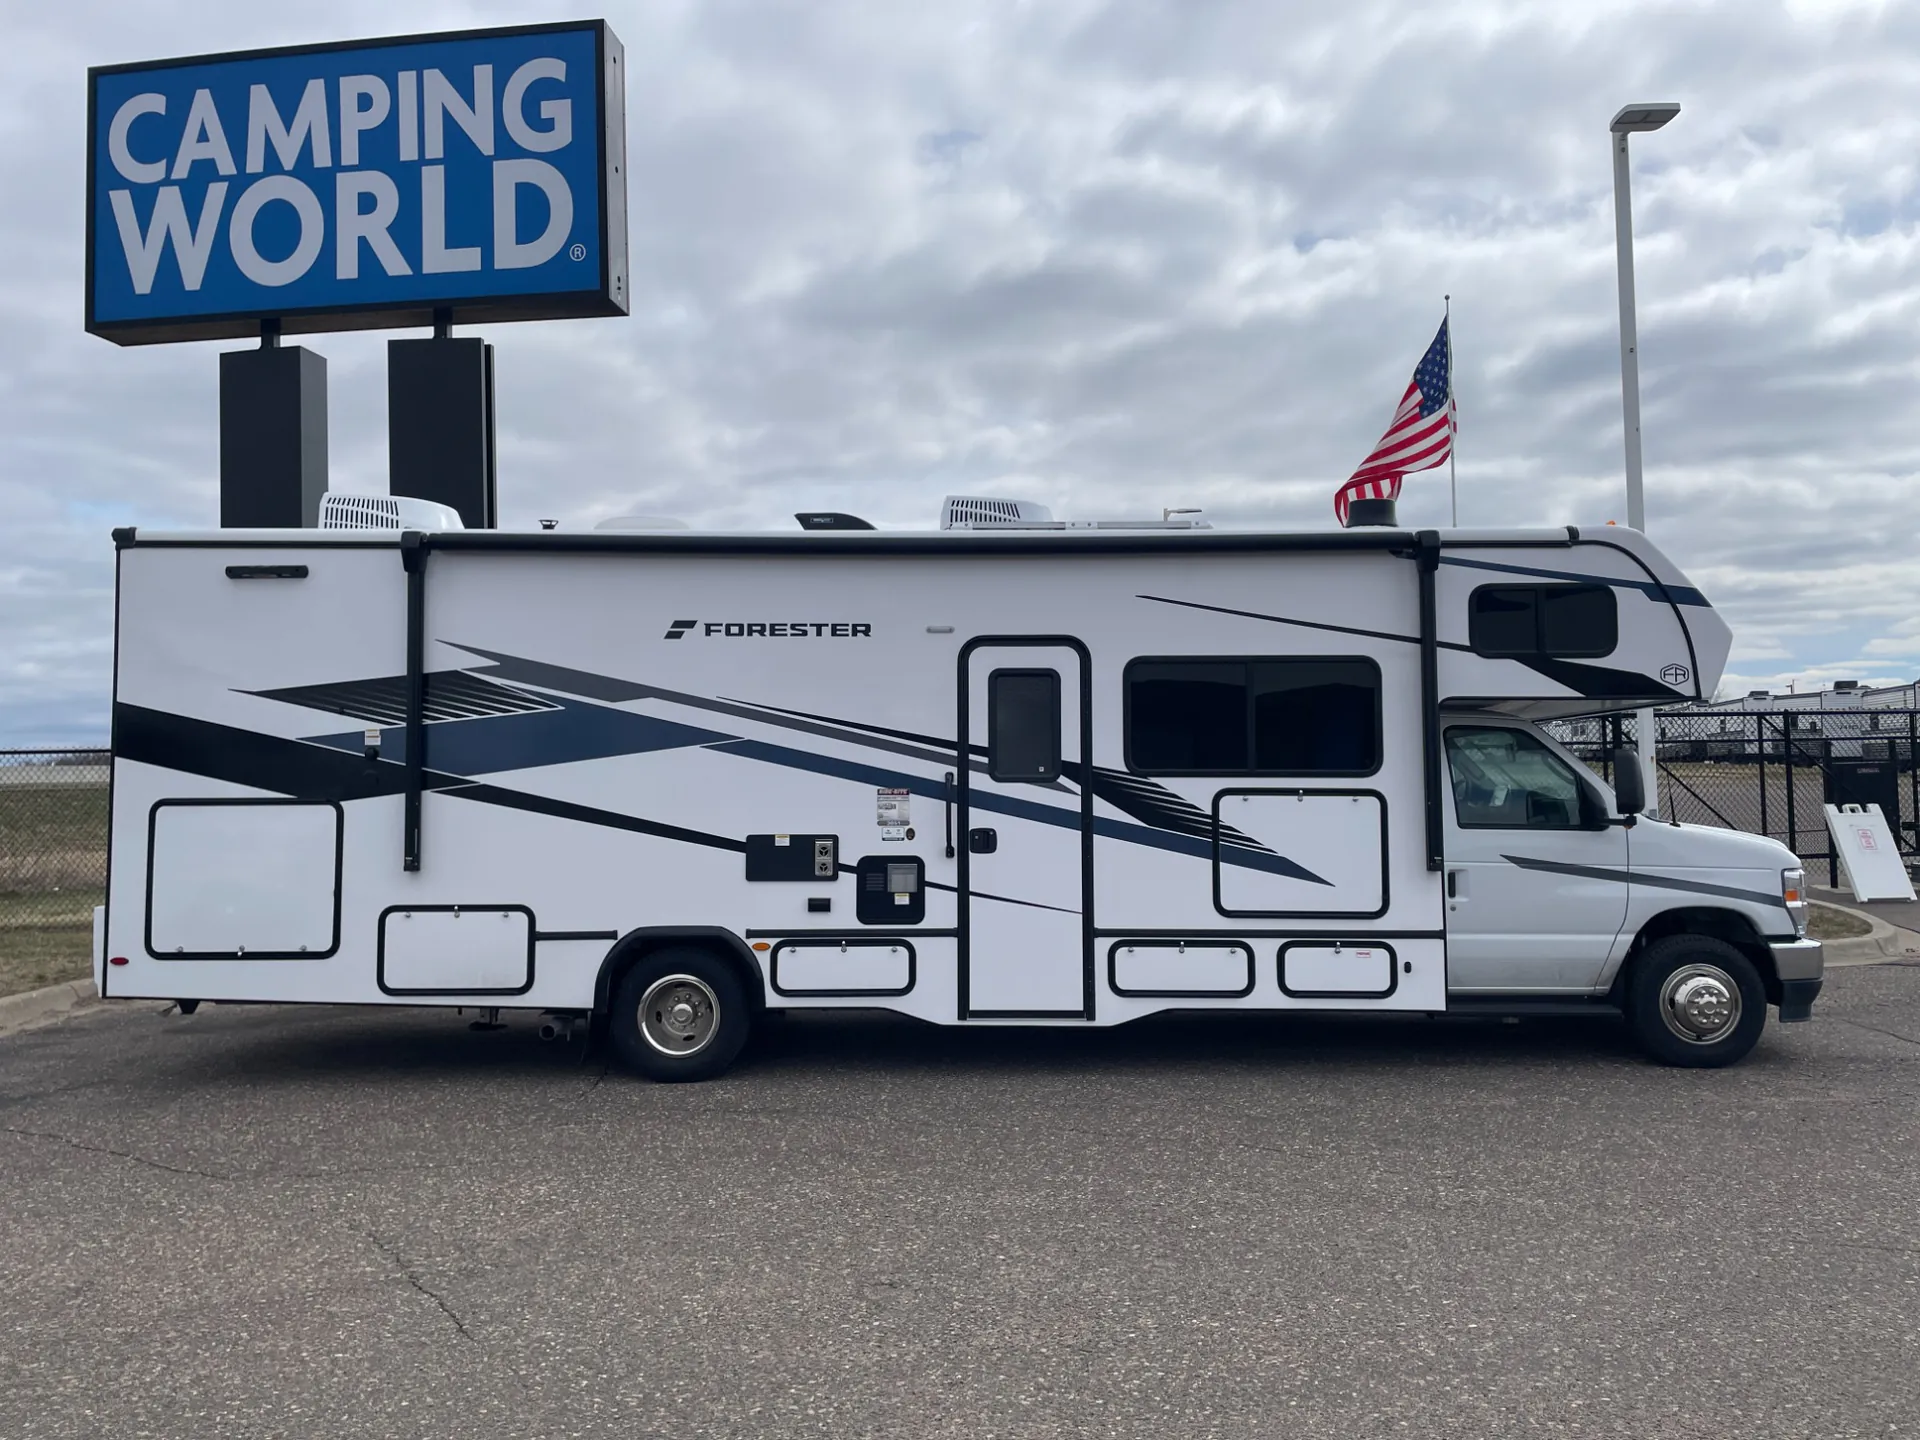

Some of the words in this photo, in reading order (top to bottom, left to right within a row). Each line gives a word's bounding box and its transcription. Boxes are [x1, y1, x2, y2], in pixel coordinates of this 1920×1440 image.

[108, 57, 572, 184] CAMPING
[108, 158, 573, 295] WORLD
[703, 622, 872, 638] FORESTER
[1662, 666, 1687, 683] FR
